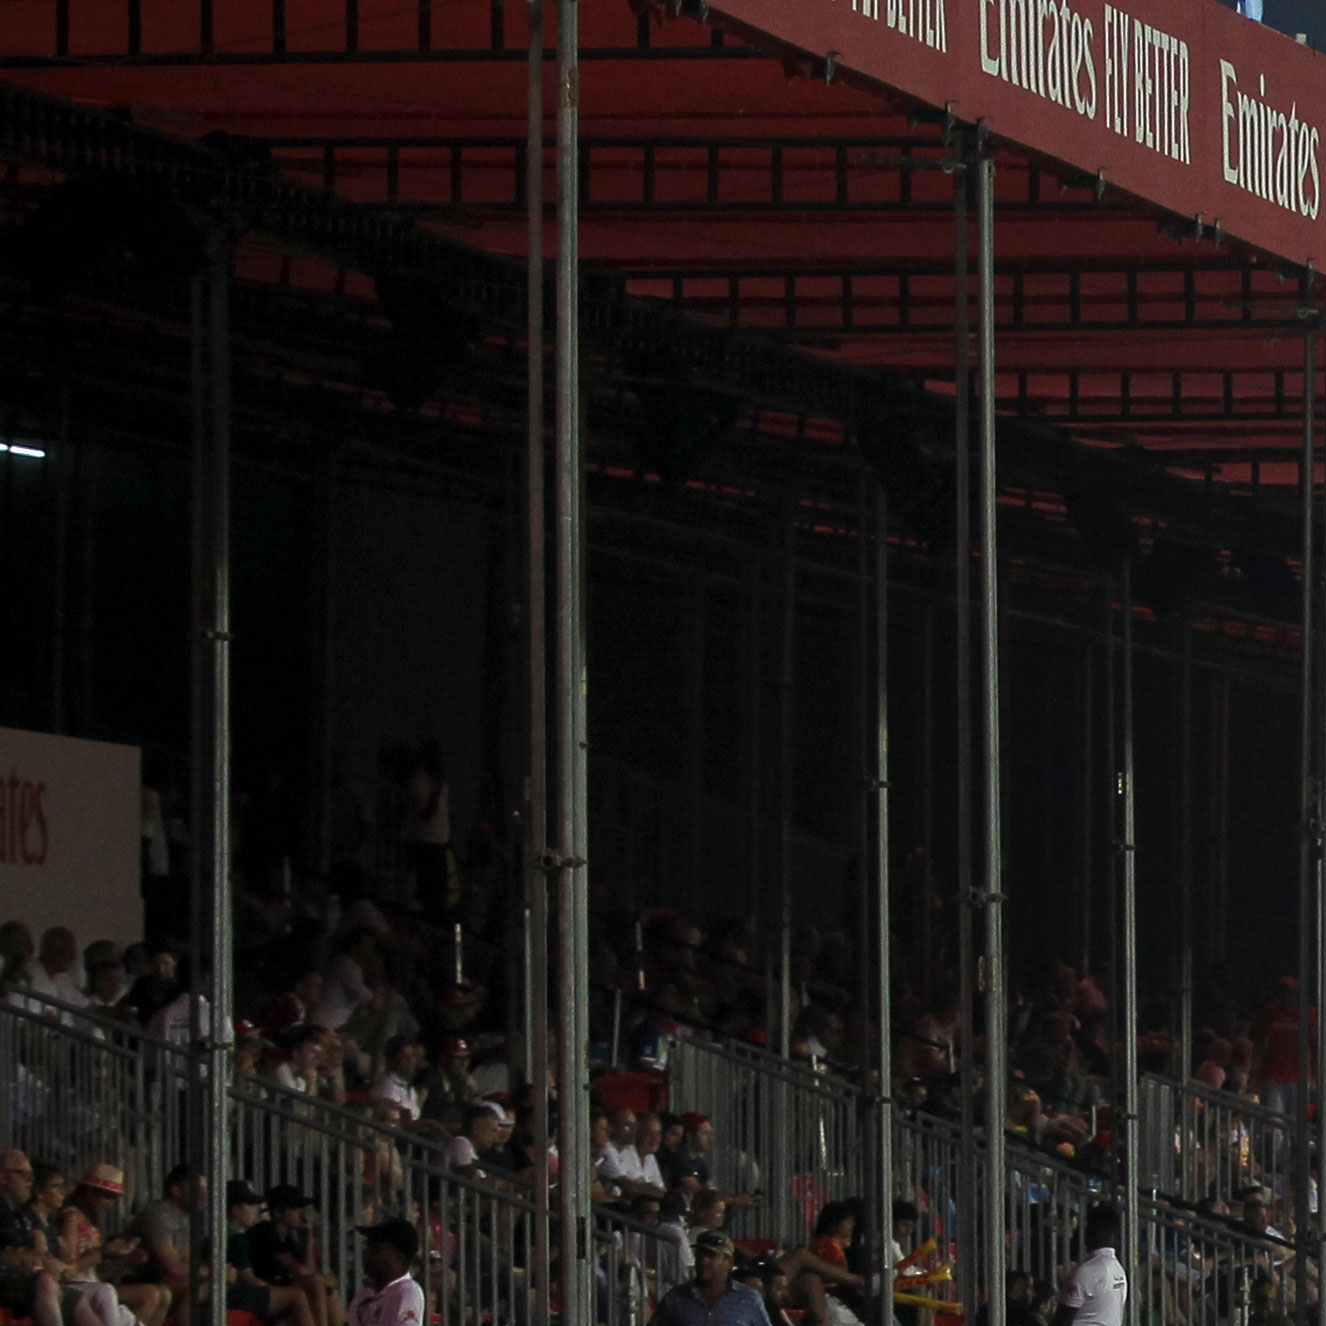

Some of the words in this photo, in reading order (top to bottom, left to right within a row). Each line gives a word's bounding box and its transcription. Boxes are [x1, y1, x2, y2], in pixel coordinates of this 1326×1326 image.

[1105, 4, 1128, 137] FLY
[1134, 19, 1190, 164] BETTER
[1220, 58, 1320, 221] Emirates
